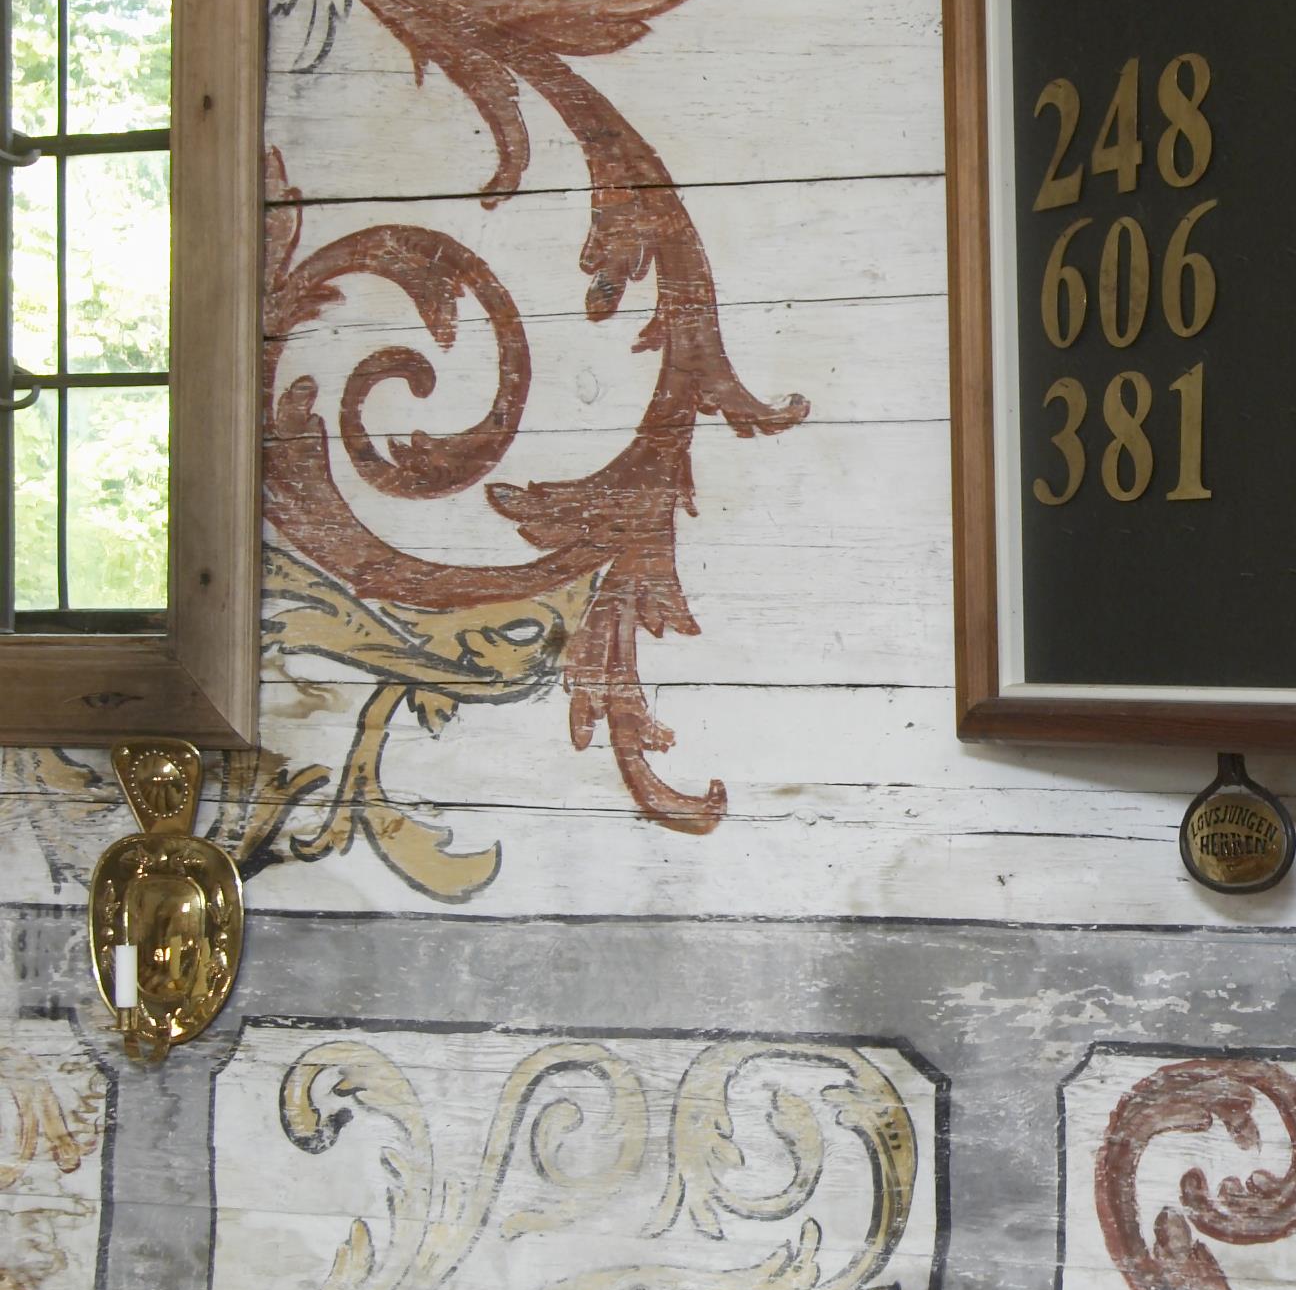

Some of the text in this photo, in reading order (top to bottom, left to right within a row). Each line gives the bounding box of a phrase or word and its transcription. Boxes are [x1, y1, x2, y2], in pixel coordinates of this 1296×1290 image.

[1032, 52, 1213, 212] 248
[1040, 198, 1218, 349] 606
[1032, 361, 1213, 506] 381
